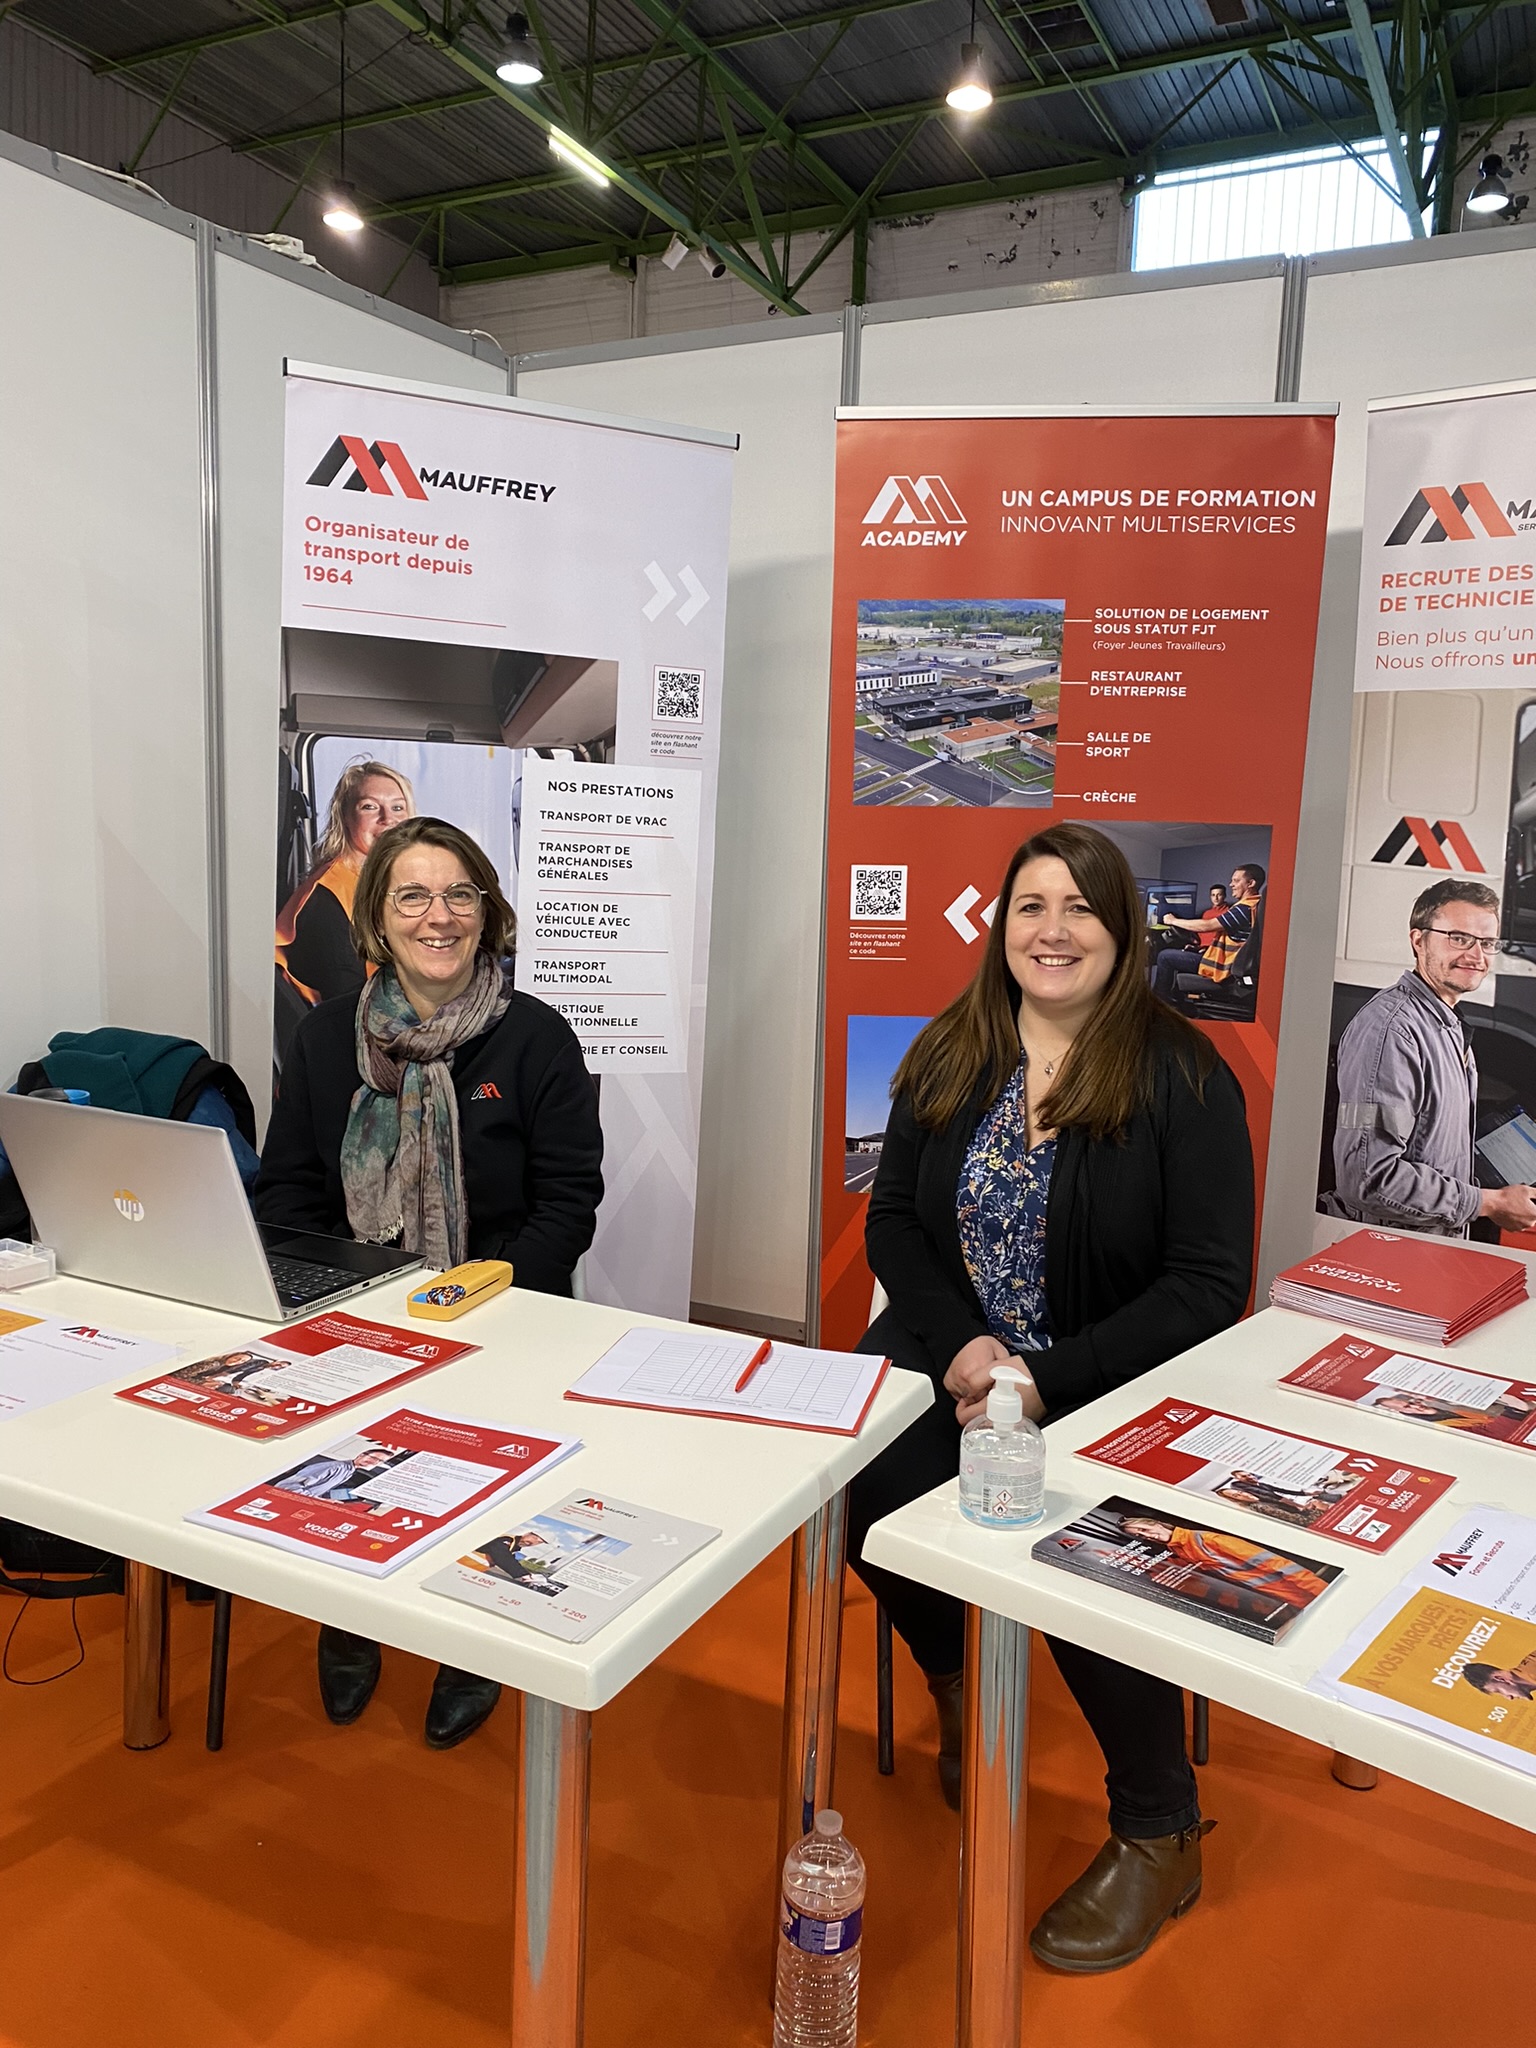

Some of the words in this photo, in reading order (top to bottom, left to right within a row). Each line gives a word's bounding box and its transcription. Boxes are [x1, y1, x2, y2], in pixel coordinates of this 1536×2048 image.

[418, 467, 557, 503] MAUFFREY
[1002, 490, 1033, 507] UN
[1039, 490, 1135, 508] CAMPUS
[1140, 490, 1170, 507] DE
[1177, 490, 1316, 508] FORMATION
[1506, 499, 1536, 519] M
[305, 516, 438, 548] Organisateur
[445, 532, 470, 550] de
[1000, 516, 1115, 534] INNOVANT
[1122, 516, 1296, 534] MULTISERVICES
[861, 530, 967, 547] ACADEMY
[304, 540, 400, 568] transport
[406, 552, 473, 577] depuis
[304, 564, 353, 586] 1964
[1381, 568, 1481, 589] RECRUTE
[1488, 564, 1534, 582] DES
[1379, 597, 1407, 613] DE
[1095, 608, 1165, 620] SOLUTION
[1170, 609, 1190, 620] DE
[1192, 609, 1269, 620] LOGEMENT
[1093, 623, 1131, 635] SOUS
[1135, 623, 1188, 635] STATUT
[1192, 623, 1216, 635] FJT
[1377, 629, 1419, 647] Bien
[1425, 627, 1467, 648] plus
[1092, 640, 1124, 652] (Foyer
[1127, 640, 1163, 650] Jeunes
[1165, 640, 1226, 652] Travailleurs)
[1375, 654, 1424, 670] Nous
[1431, 651, 1505, 668] offrons
[1091, 671, 1182, 682] RESTAURANT
[1090, 686, 1187, 698] D'ENTREPRISE
[685, 734, 702, 742] notre
[1087, 731, 1127, 743] SALLE
[1132, 732, 1151, 743] DE
[1085, 746, 1130, 758] SPORT
[548, 781, 577, 793] NOS
[581, 783, 674, 799] PRESTATIONS
[1083, 789, 1137, 803] CRÈCHE
[540, 810, 612, 824] TRANSPORT
[616, 815, 631, 825] DE
[635, 816, 667, 827] VRAC
[539, 842, 611, 855] TRANSPORT
[615, 846, 630, 855] DE
[538, 856, 633, 869] MARCHANDISES
[538, 868, 609, 881] GÉNÉRALES
[536, 902, 599, 913] LOCATION
[603, 904, 618, 913] DE
[536, 913, 595, 926] VÉHICULE
[599, 917, 631, 927] AVEC
[535, 928, 618, 939] CONDUCTEUR
[534, 960, 606, 971] TRANSPORT
[533, 974, 613, 984] MULTIMODAL
[551, 1004, 604, 1013] GISTIQUE
[602, 1046, 615, 1055] ET
[619, 1046, 668, 1055] CONSEIL
[1302, 1267, 1402, 1293] MAUFFREY
[1309, 1264, 1400, 1286] ACADEMY
[403, 1416, 422, 1425] TITRE
[304, 1522, 348, 1540] VOSGES
[1455, 1528, 1484, 1554] MAUFFREY
[1469, 1562, 1487, 1576] Forme
[1485, 1540, 1505, 1557] Recrute
[1427, 1613, 1468, 1651] PRÊTS
[1371, 1648, 1403, 1679] VOS
[1396, 1604, 1444, 1659] MARQUES
[1432, 1622, 1498, 1690] DÉCOUVREZ
[1487, 1705, 1509, 1723] 500
